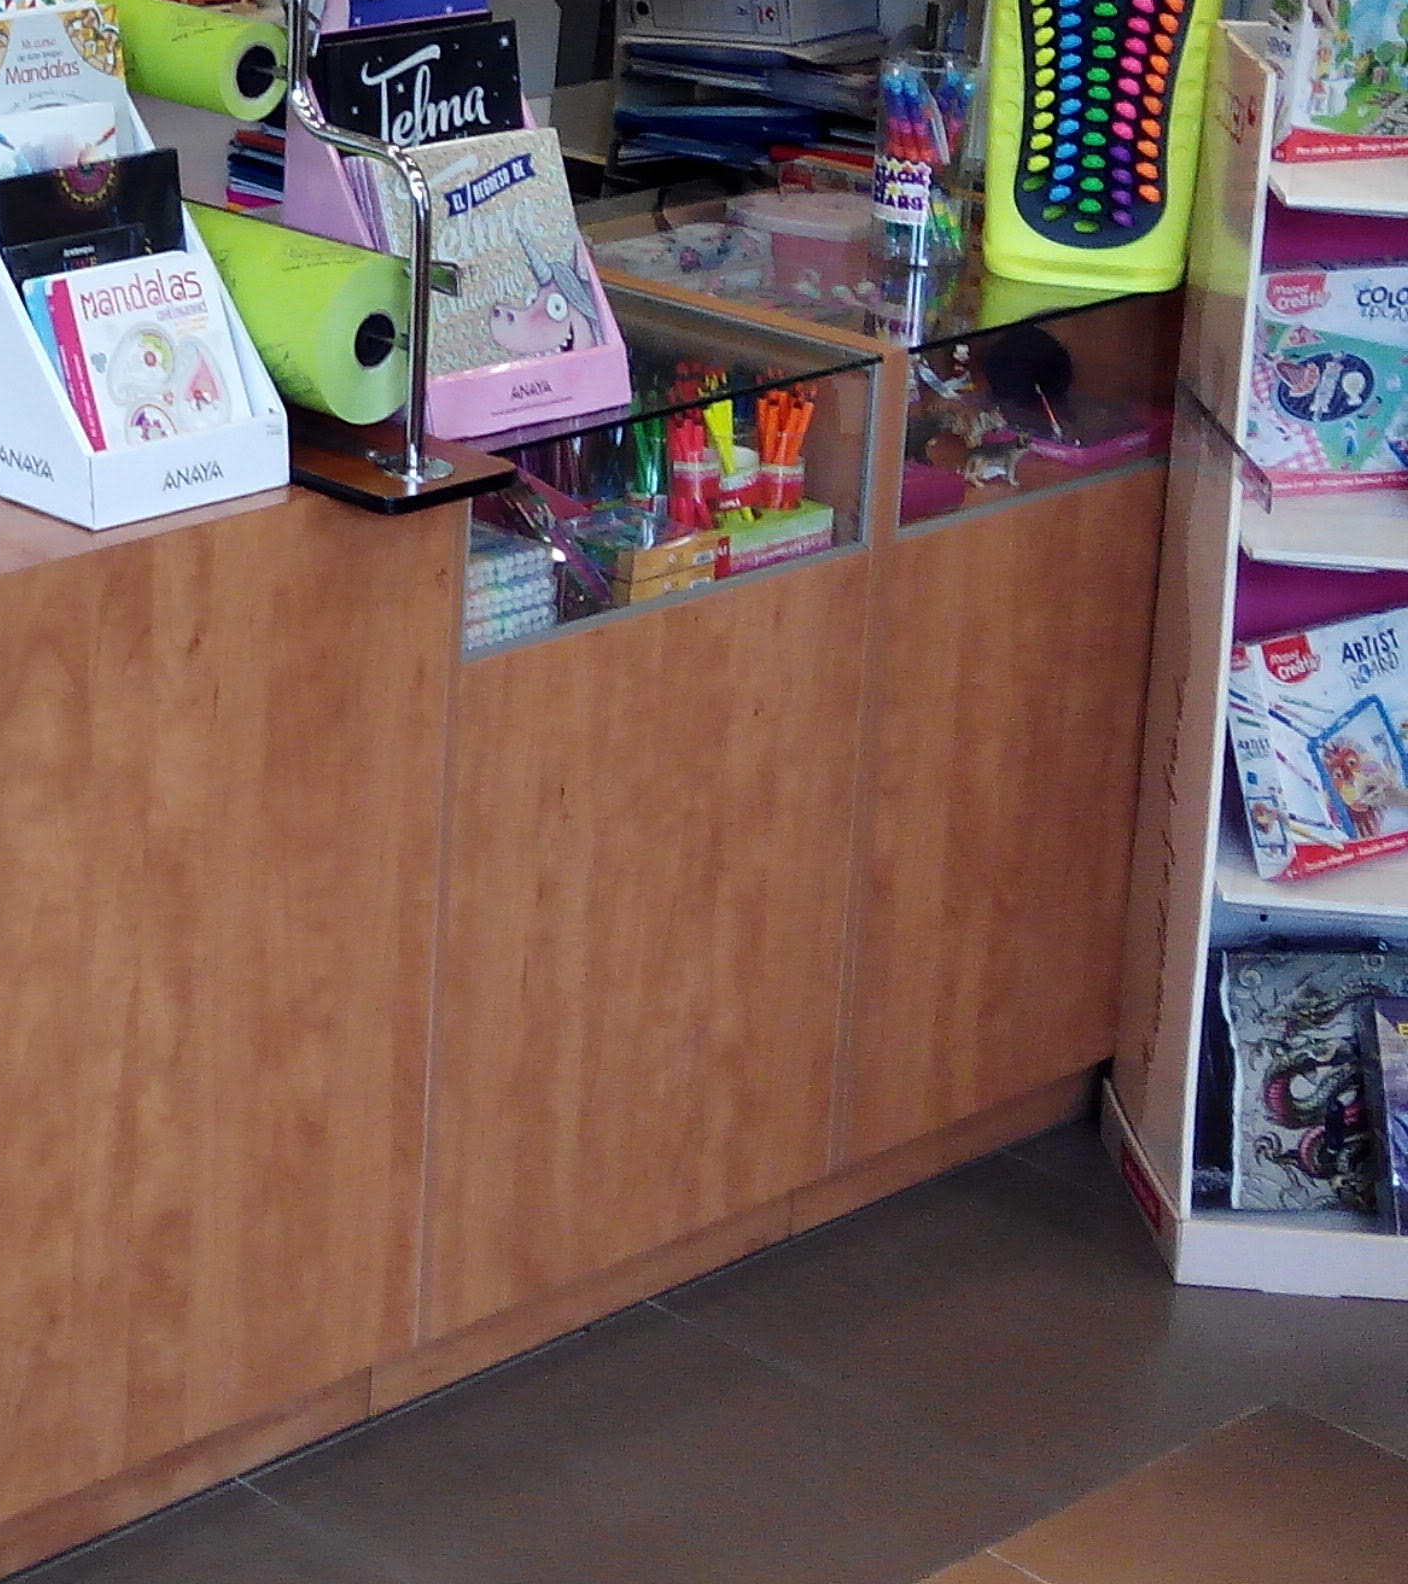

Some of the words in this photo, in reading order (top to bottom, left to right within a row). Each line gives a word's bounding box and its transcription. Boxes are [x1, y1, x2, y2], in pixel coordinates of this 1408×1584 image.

[5, 59, 80, 85] Mandalas
[361, 44, 491, 146] Telma
[451, 193, 466, 212] EL
[472, 167, 510, 203] REGRESO
[512, 159, 526, 180] DE
[511, 379, 553, 401] ANAYA
[162, 460, 224, 492] ANAYA
[1341, 627, 1399, 665] ARTIST
